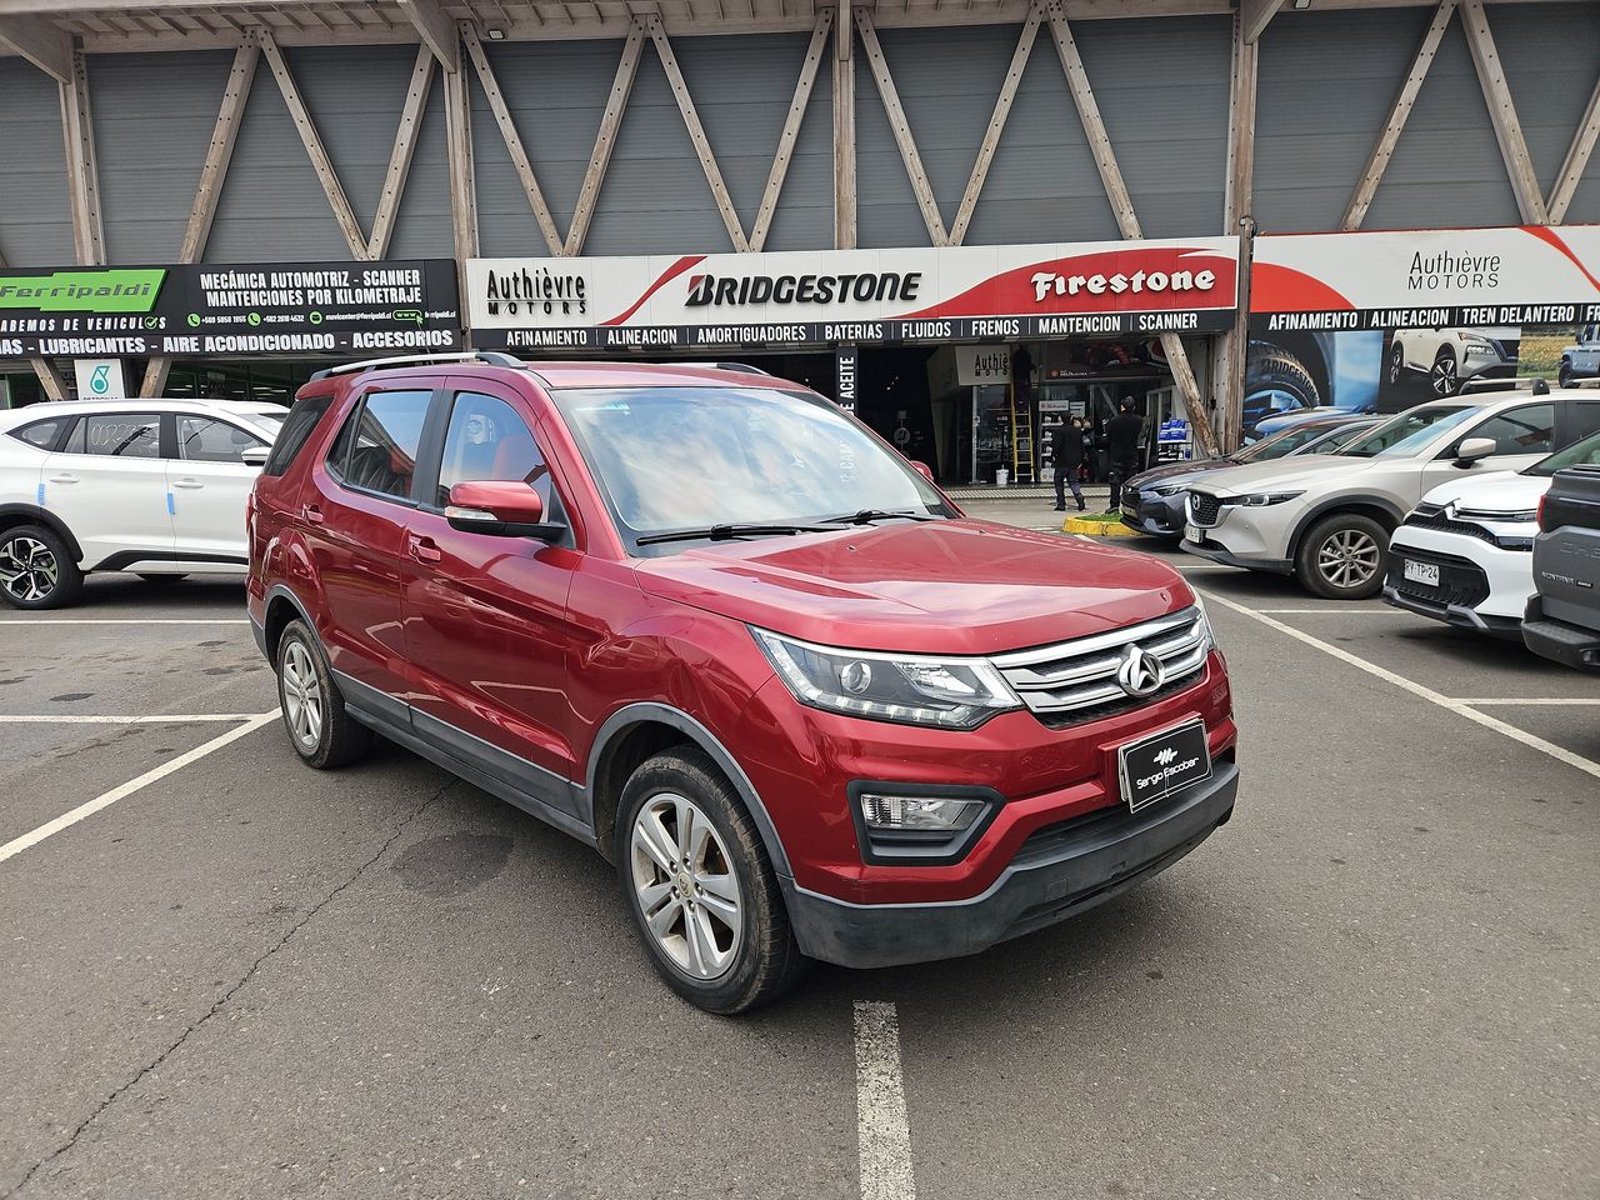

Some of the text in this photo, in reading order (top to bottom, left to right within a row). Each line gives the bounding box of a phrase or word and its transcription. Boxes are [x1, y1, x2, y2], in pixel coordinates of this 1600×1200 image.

[1409, 250, 1500, 275] Authièvre
[200, 270, 266, 290] MECÁNICA
[270, 271, 350, 288] AUTOMOTRIZ
[363, 269, 420, 286] SCANNER
[487, 266, 585, 299] Authièvre
[684, 273, 922, 307] BRIDGESTONE
[1031, 269, 1216, 302] Firestone
[1408, 273, 1499, 291] MOTORS
[0, 283, 150, 299] Ferripaldi
[206, 287, 422, 307] MANTENCIONES POR KILOMETRAJE
[488, 301, 587, 315] MOTORS
[1268, 312, 1358, 330] AFINAMIENTO
[1370, 309, 1449, 327] ALINEACION
[1462, 307, 1497, 324] TREN
[1499, 305, 1575, 323] DELANTERO
[63, 318, 79, 331] DE
[506, 313, 1198, 346] AFINAMIENTO ALINEACION AMORTIGUADORES BATERIAS FLUIDOS FRENOS MANTENCION SCANNER
[0, 339, 23, 355] AS
[39, 337, 146, 355] LUBRICANTES
[163, 335, 200, 353] AIRE
[204, 333, 335, 352] ACONDICIONADO
[352, 330, 453, 348] ACCESORIOS
[975, 352, 1009, 370] Authiè
[839, 357, 855, 399] ACEITE
[975, 369, 1009, 377] MOTO
[1163, 757, 1200, 778] Escobar
